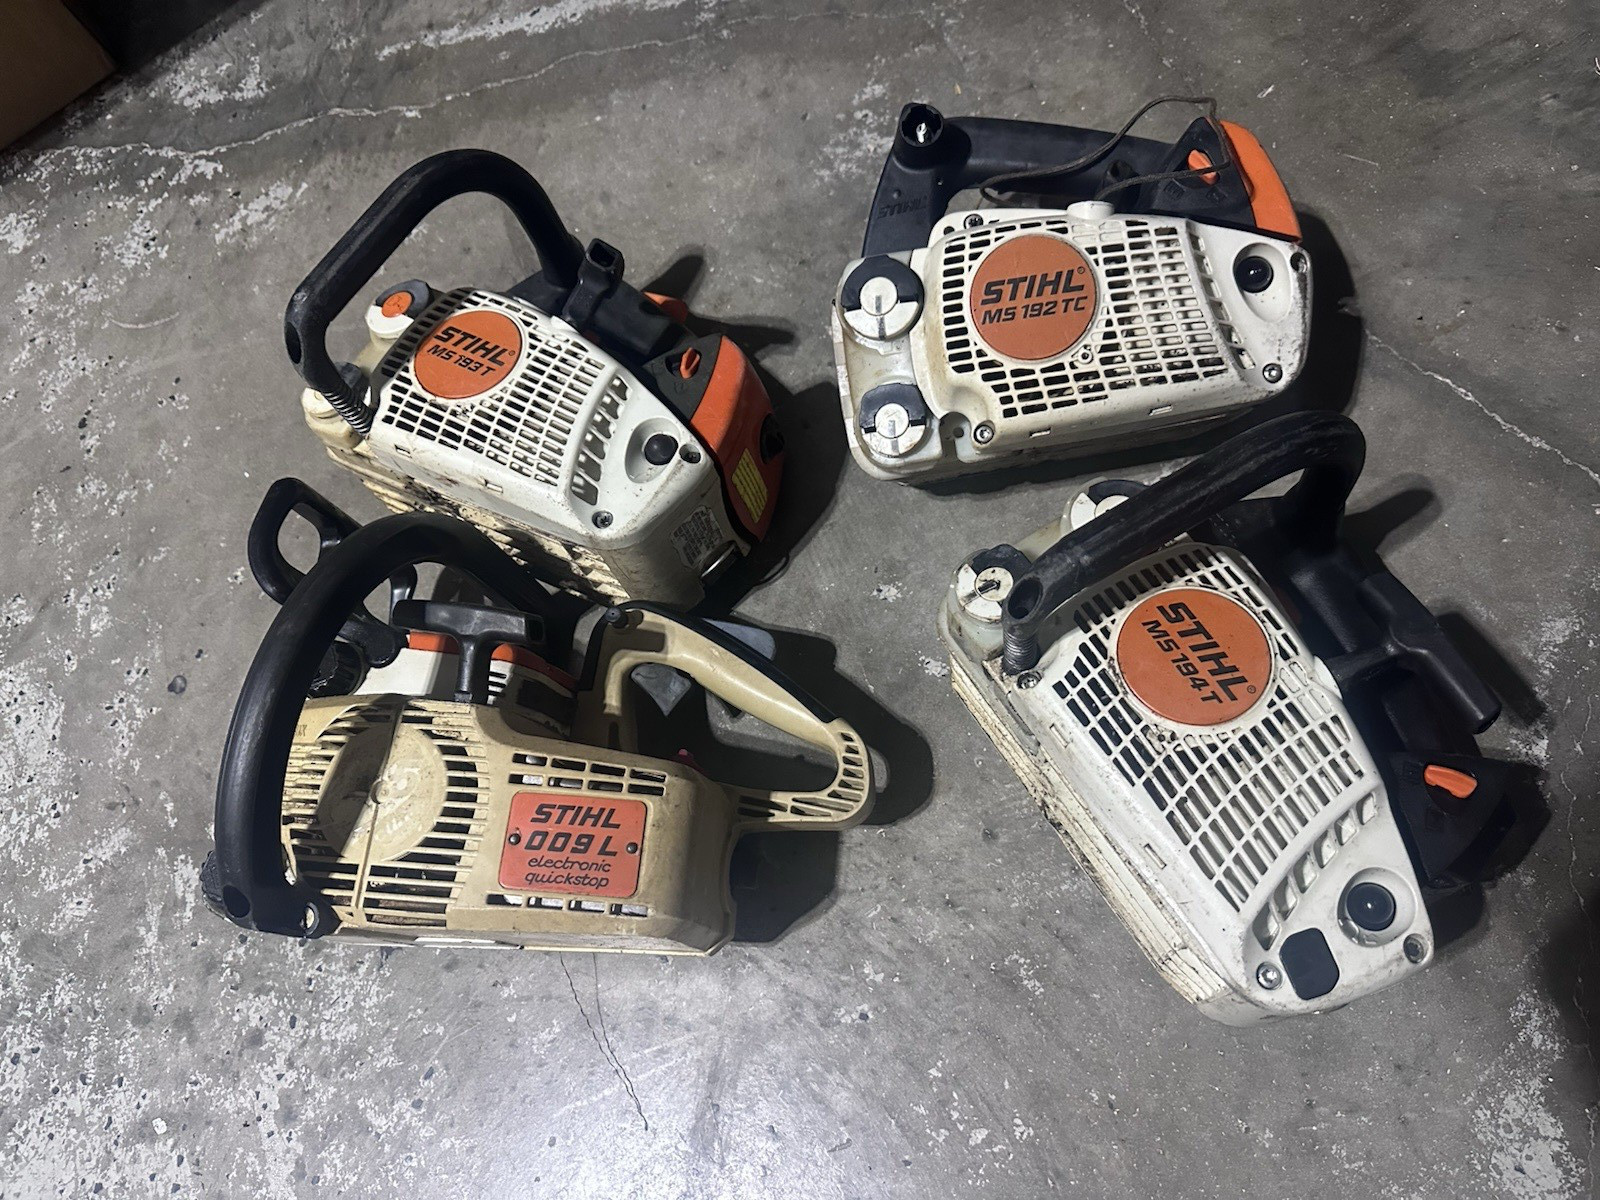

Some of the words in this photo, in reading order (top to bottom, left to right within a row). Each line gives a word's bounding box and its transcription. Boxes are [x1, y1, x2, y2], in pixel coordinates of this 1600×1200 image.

[980, 268, 1085, 306] STIHL
[981, 306, 1017, 325] MS
[1021, 300, 1058, 319] 192
[1061, 296, 1088, 314] TC
[426, 344, 457, 361] MS
[433, 326, 508, 367] STIHL
[1141, 619, 1181, 653] MS
[1156, 601, 1248, 702] STIHL
[530, 803, 622, 830] STIHL
[524, 830, 595, 854] 009
[597, 835, 618, 857] L
[528, 855, 612, 873] electronic
[524, 871, 610, 890] quickstop
